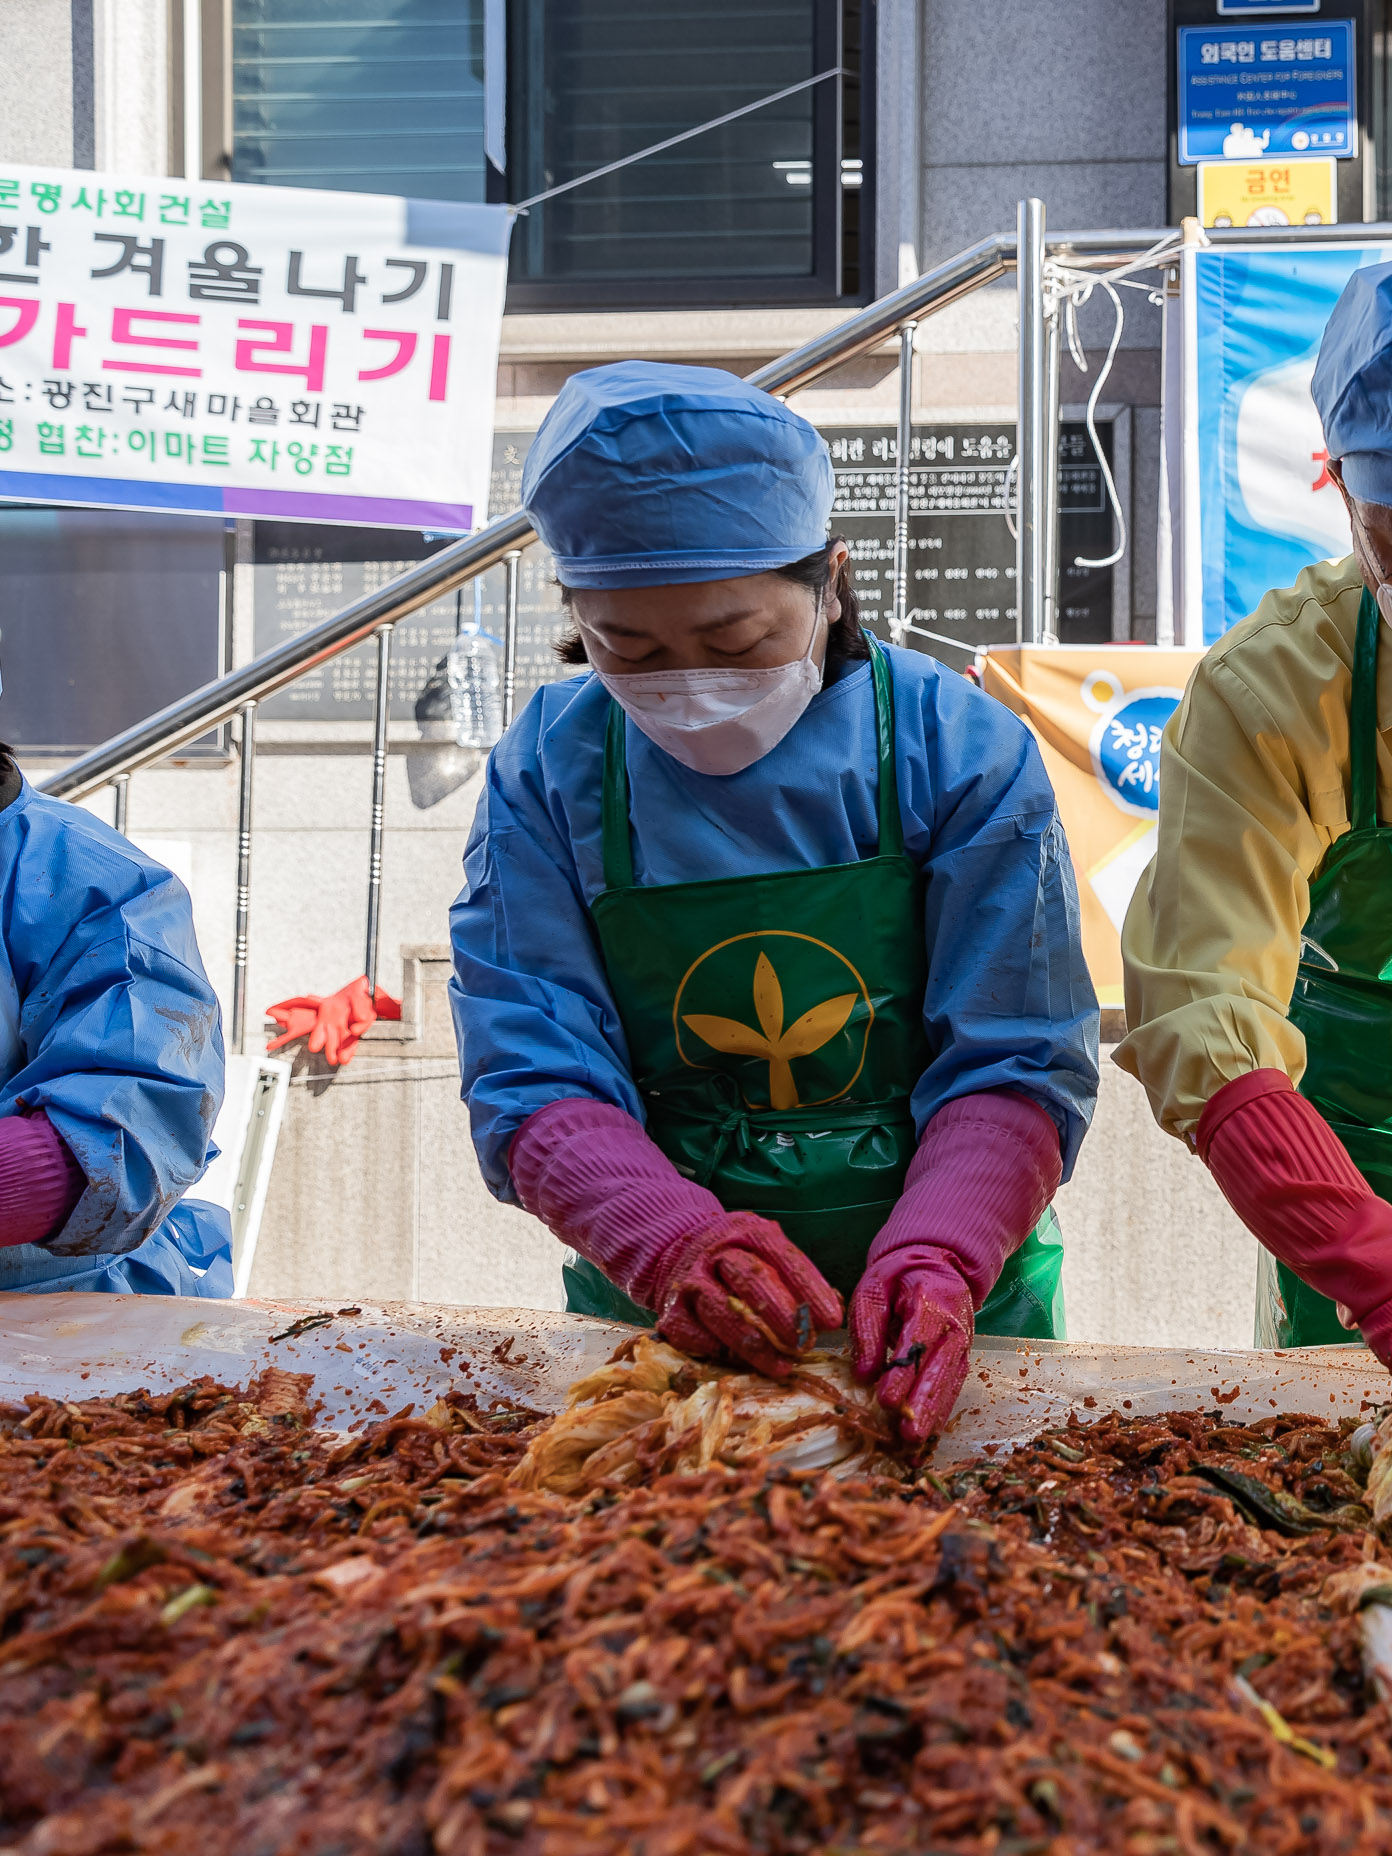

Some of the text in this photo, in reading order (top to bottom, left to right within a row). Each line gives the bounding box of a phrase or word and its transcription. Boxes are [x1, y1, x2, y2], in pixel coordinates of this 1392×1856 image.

[1201, 38, 1332, 64] 외국인 도움센터
[1245, 169, 1291, 195] 금연
[91, 231, 456, 321] 겨울나기
[0, 296, 452, 402] 가드리기
[37, 421, 232, 468] 협찬:이마트
[248, 437, 355, 478] 자양점
